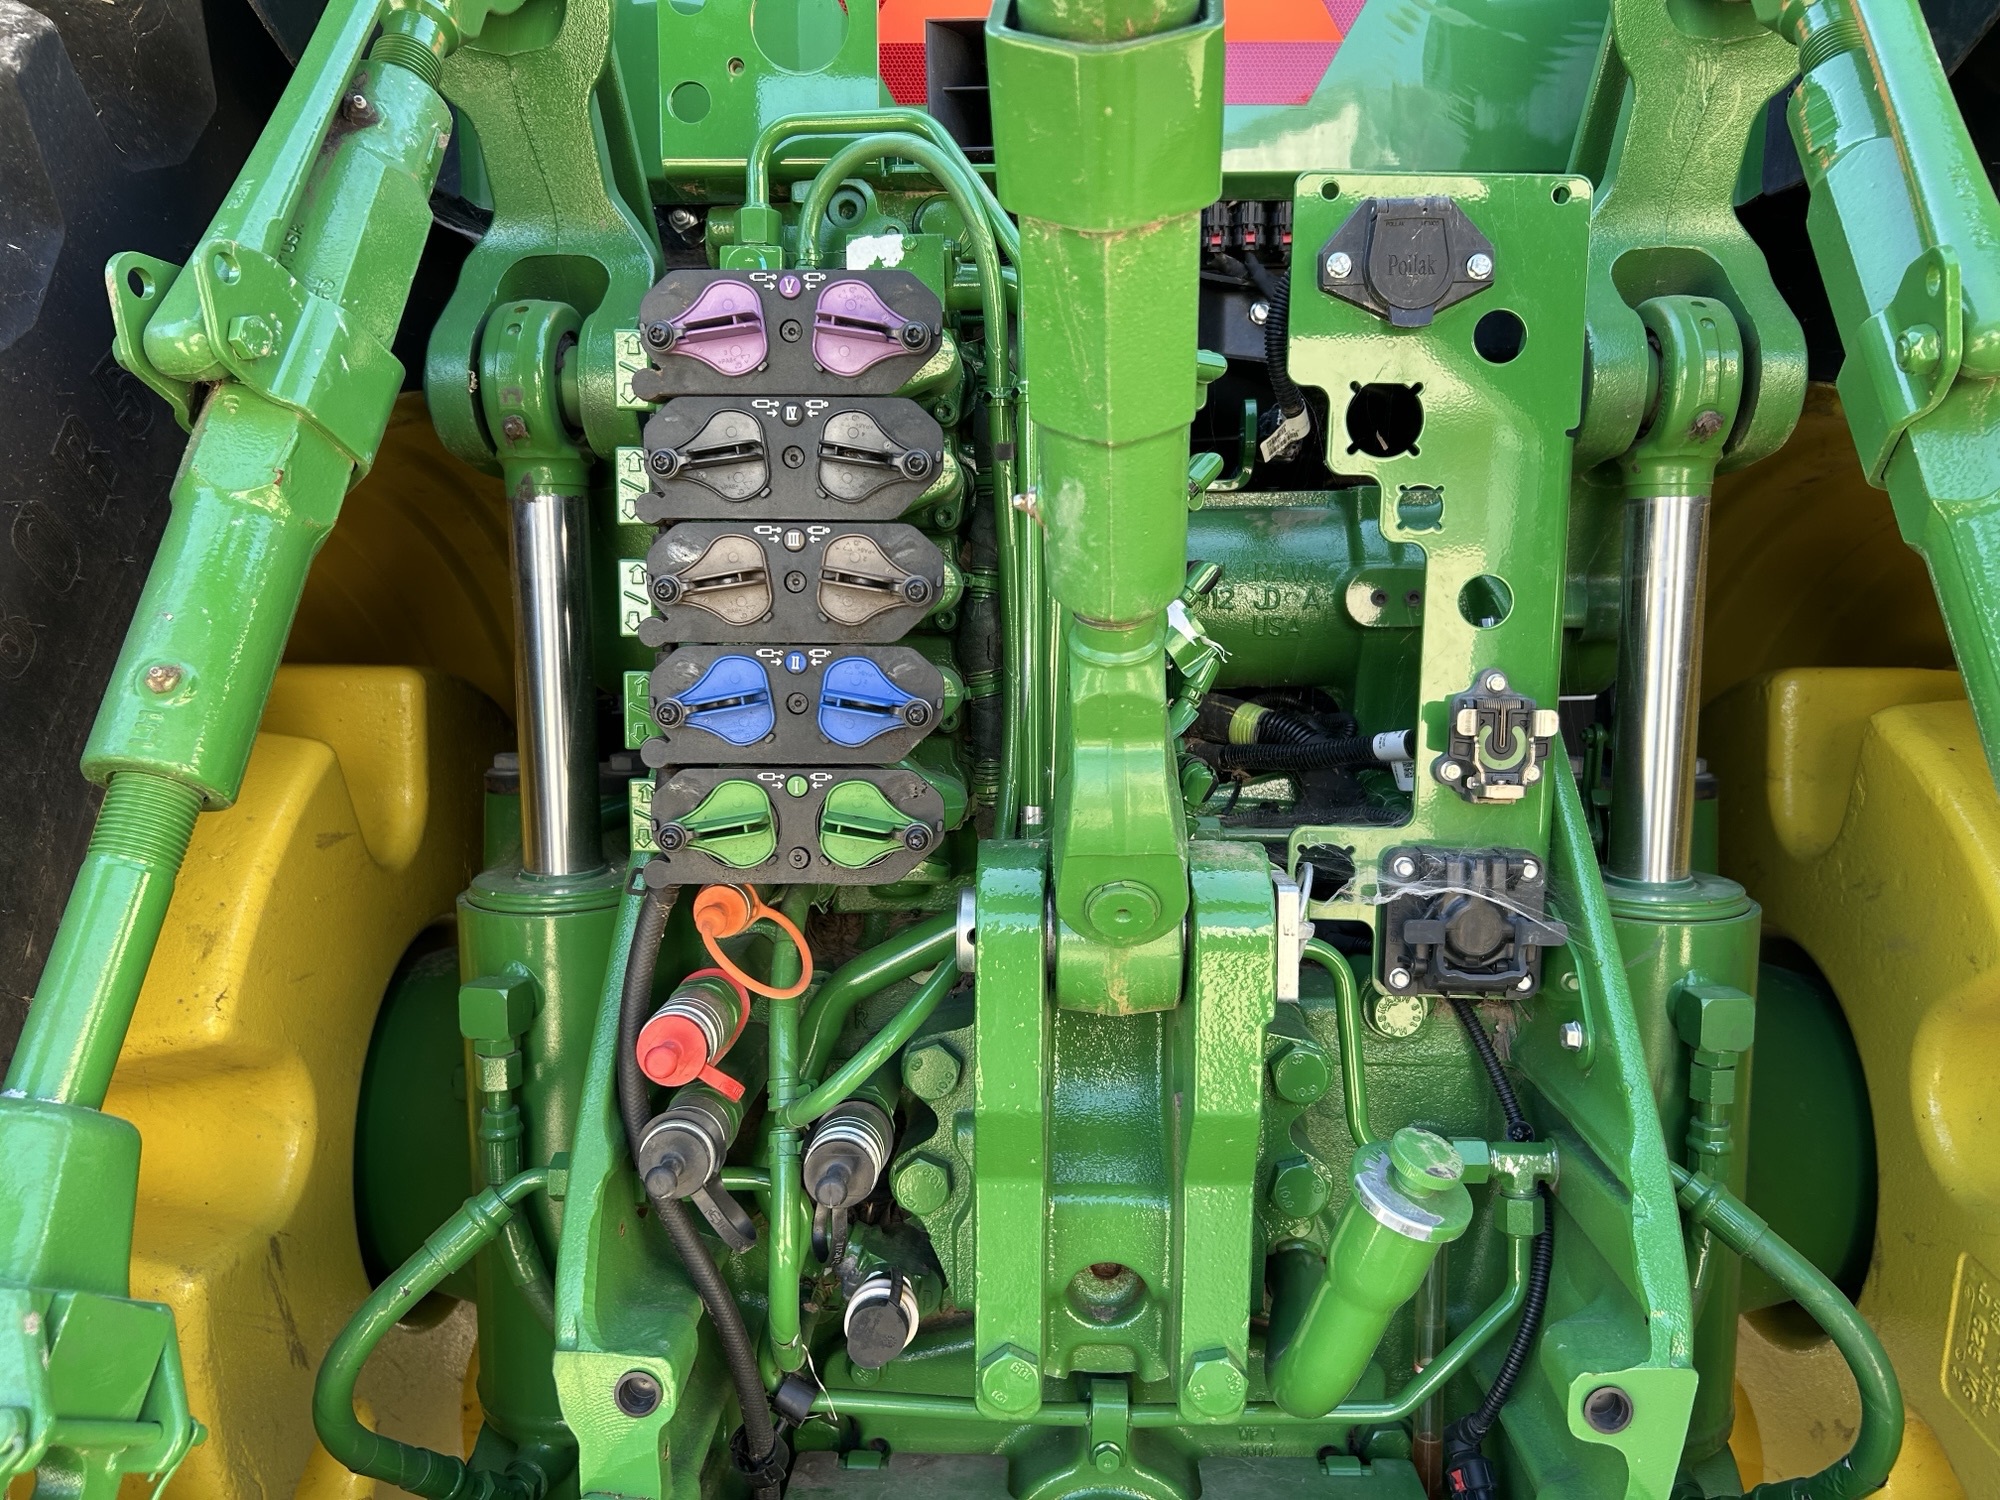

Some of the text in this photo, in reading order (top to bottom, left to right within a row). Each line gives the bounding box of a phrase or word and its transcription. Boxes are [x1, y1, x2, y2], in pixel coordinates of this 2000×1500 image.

[1386, 253, 1438, 276] Pollak
[784, 278, 795, 294] V
[786, 406, 797, 419] IV
[787, 532, 801, 547] III
[1252, 614, 1301, 637] USA
[791, 655, 800, 670] II
[794, 780, 800, 794] I
